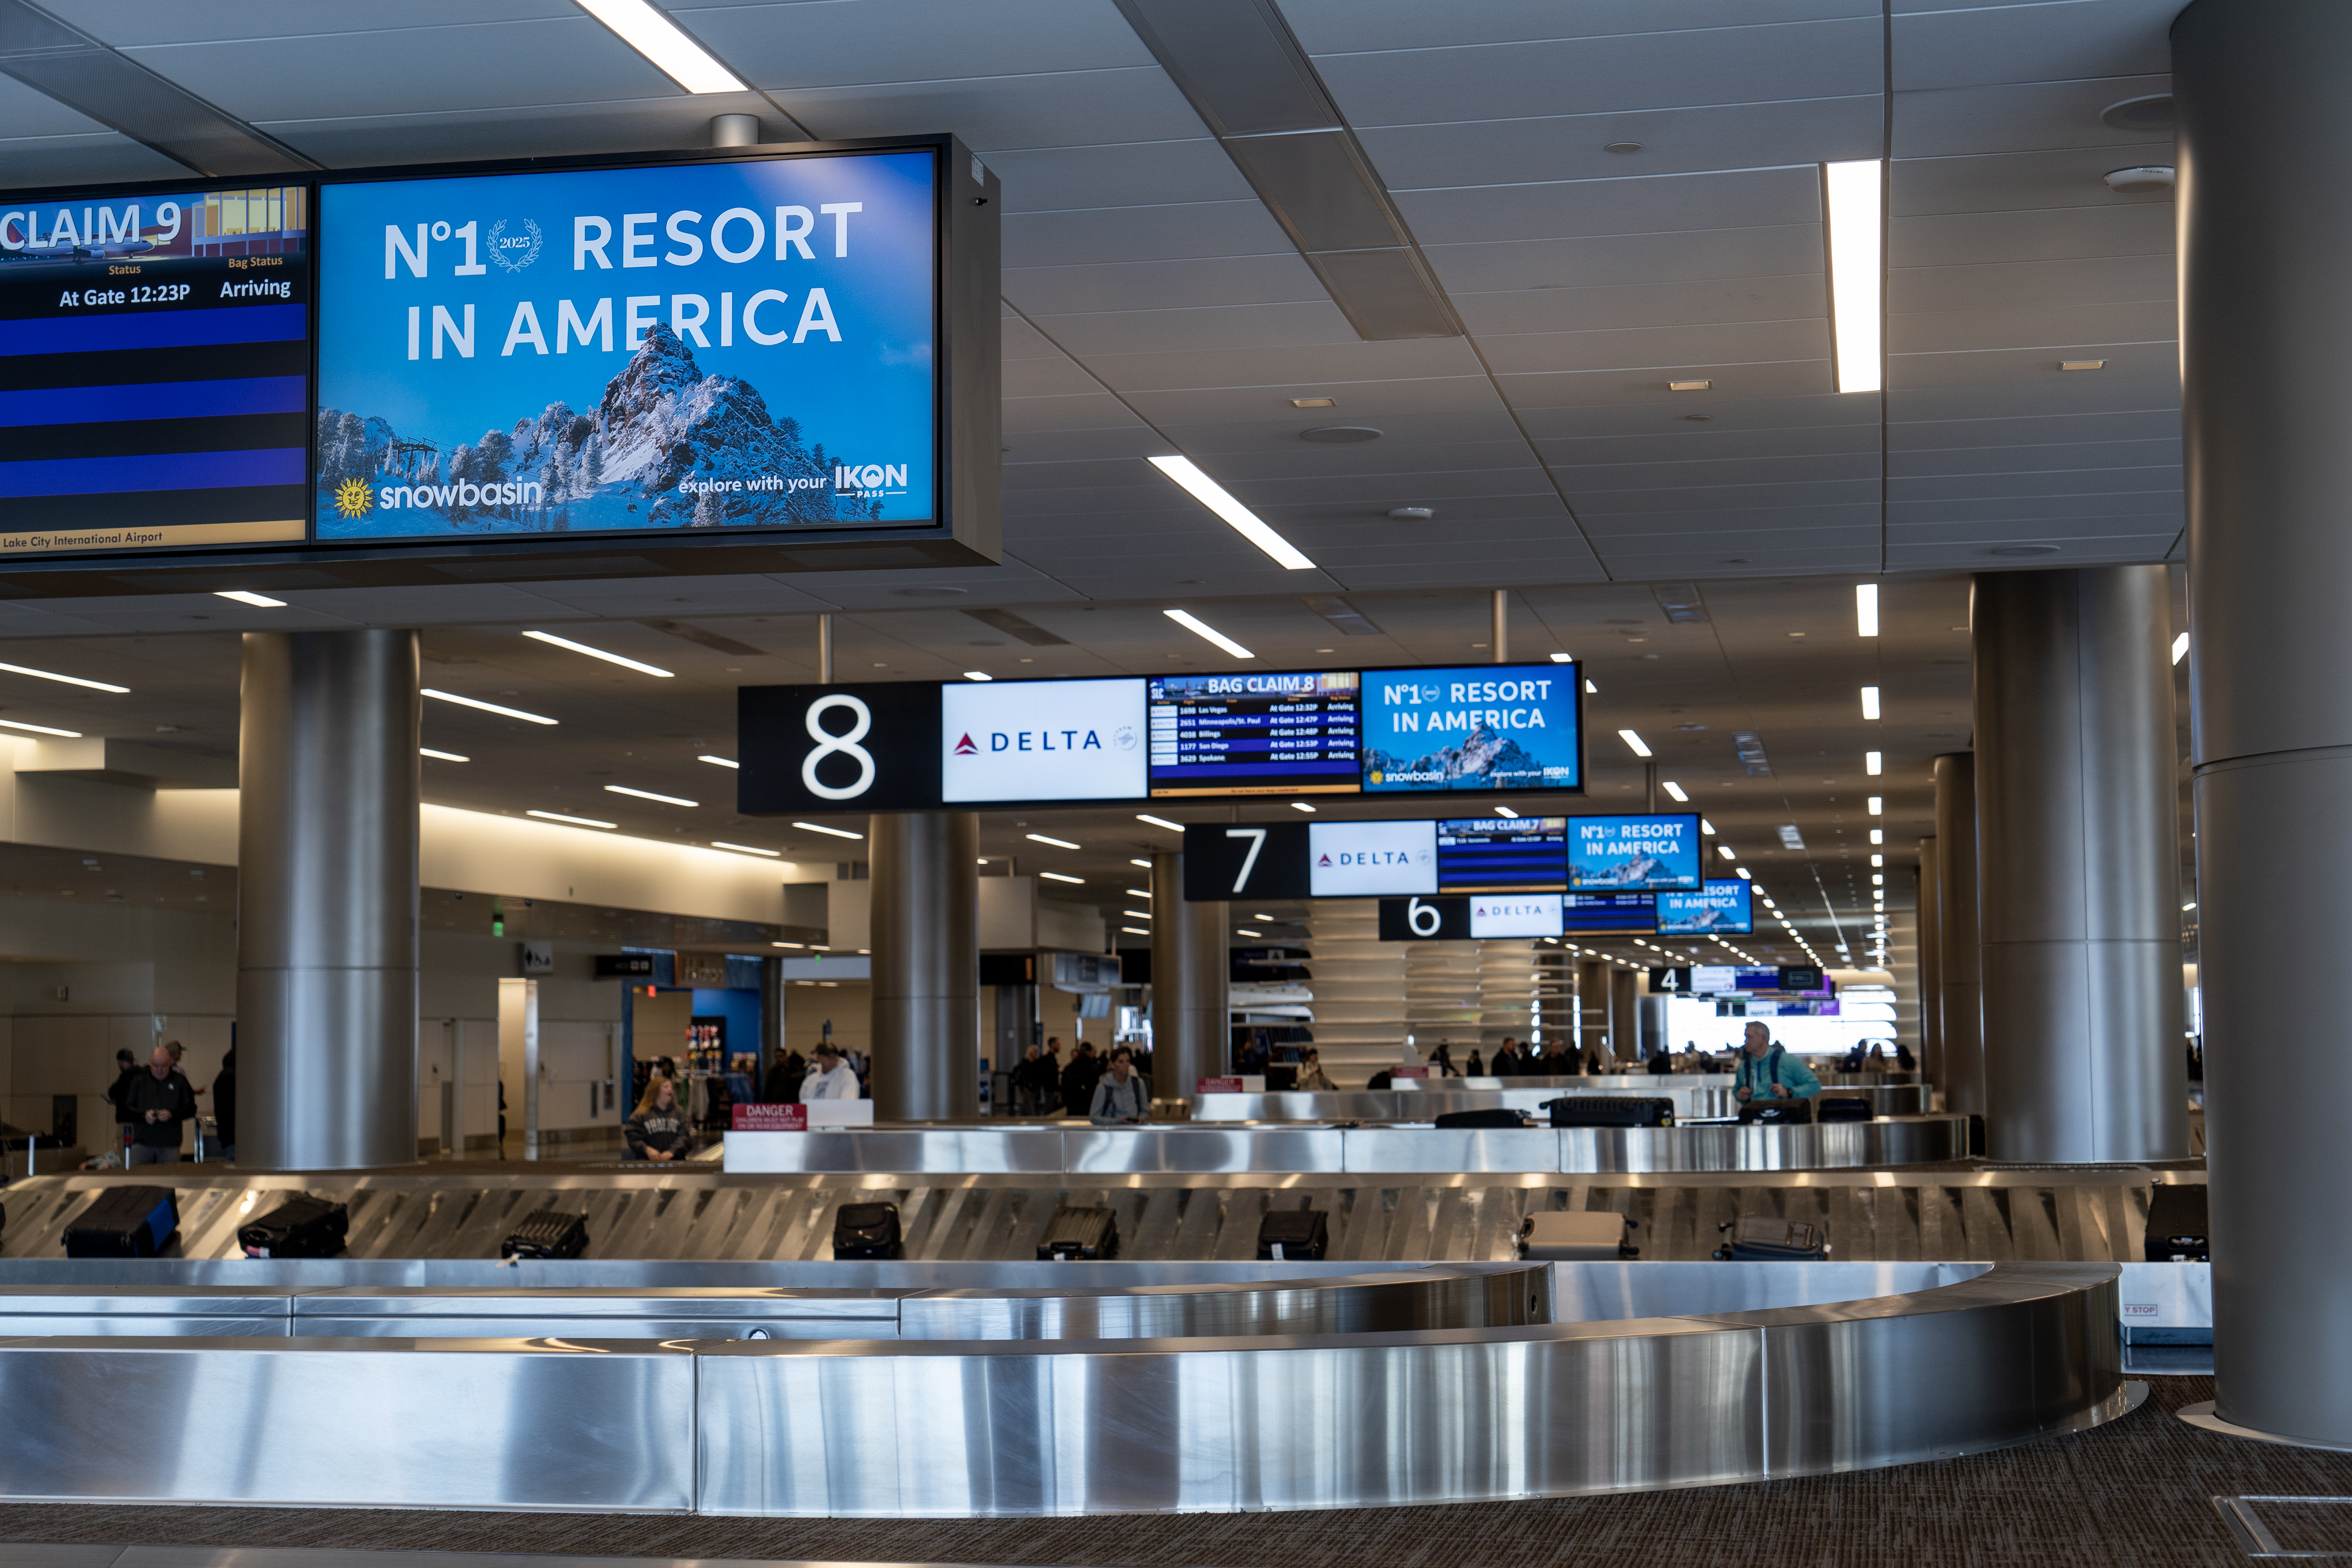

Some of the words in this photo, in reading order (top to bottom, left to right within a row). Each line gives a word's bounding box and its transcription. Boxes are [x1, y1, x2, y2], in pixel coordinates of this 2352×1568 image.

[0, 205, 140, 250] CLAIM
[157, 202, 181, 241] 9
[499, 236, 530, 249] 2025
[574, 202, 862, 270] RESORT
[109, 265, 141, 275] Status
[229, 257, 247, 269] Bag
[250, 256, 283, 267] Status
[60, 291, 79, 307] At
[84, 289, 125, 305] Gate
[131, 284, 190, 303] 12:23P
[220, 279, 291, 298] Arriving
[408, 304, 475, 360] IN
[501, 288, 842, 356] AMERICA
[679, 477, 742, 497] explore
[746, 475, 783, 492] with
[788, 477, 827, 494] your
[835, 464, 907, 489] IKON
[380, 476, 541, 510] snowbasin
[857, 490, 885, 498] PASS
[3, 538, 27, 548] Lake
[31, 536, 51, 548] City
[54, 533, 121, 546] International
[125, 532, 162, 544] Airport
[1208, 678, 1243, 693] BAG
[1247, 676, 1300, 692] CLAIM
[1304, 675, 1315, 691] 8
[1451, 680, 1552, 703] RESORT
[1393, 712, 1419, 732] IN
[1427, 708, 1545, 731] AMERICA
[802, 694, 876, 800] 8
[991, 730, 1102, 752] DELTA
[1385, 769, 1444, 782] snowbasin
[1543, 766, 1569, 776] IKON
[1474, 820, 1496, 831] BAG
[1497, 820, 1529, 830] CLAIM
[1531, 819, 1539, 830] 7
[1621, 824, 1683, 838] RESORT
[1586, 842, 1603, 856] IN
[1607, 840, 1680, 855] AMERICA
[1226, 829, 1267, 893] 7
[1340, 852, 1409, 866] DELTA
[1492, 905, 1542, 916] DELTA
[1684, 897, 1738, 909] AMERICA
[1408, 897, 1441, 937] 6
[1661, 968, 1680, 992] 4
[746, 1104, 794, 1117] DANGER
